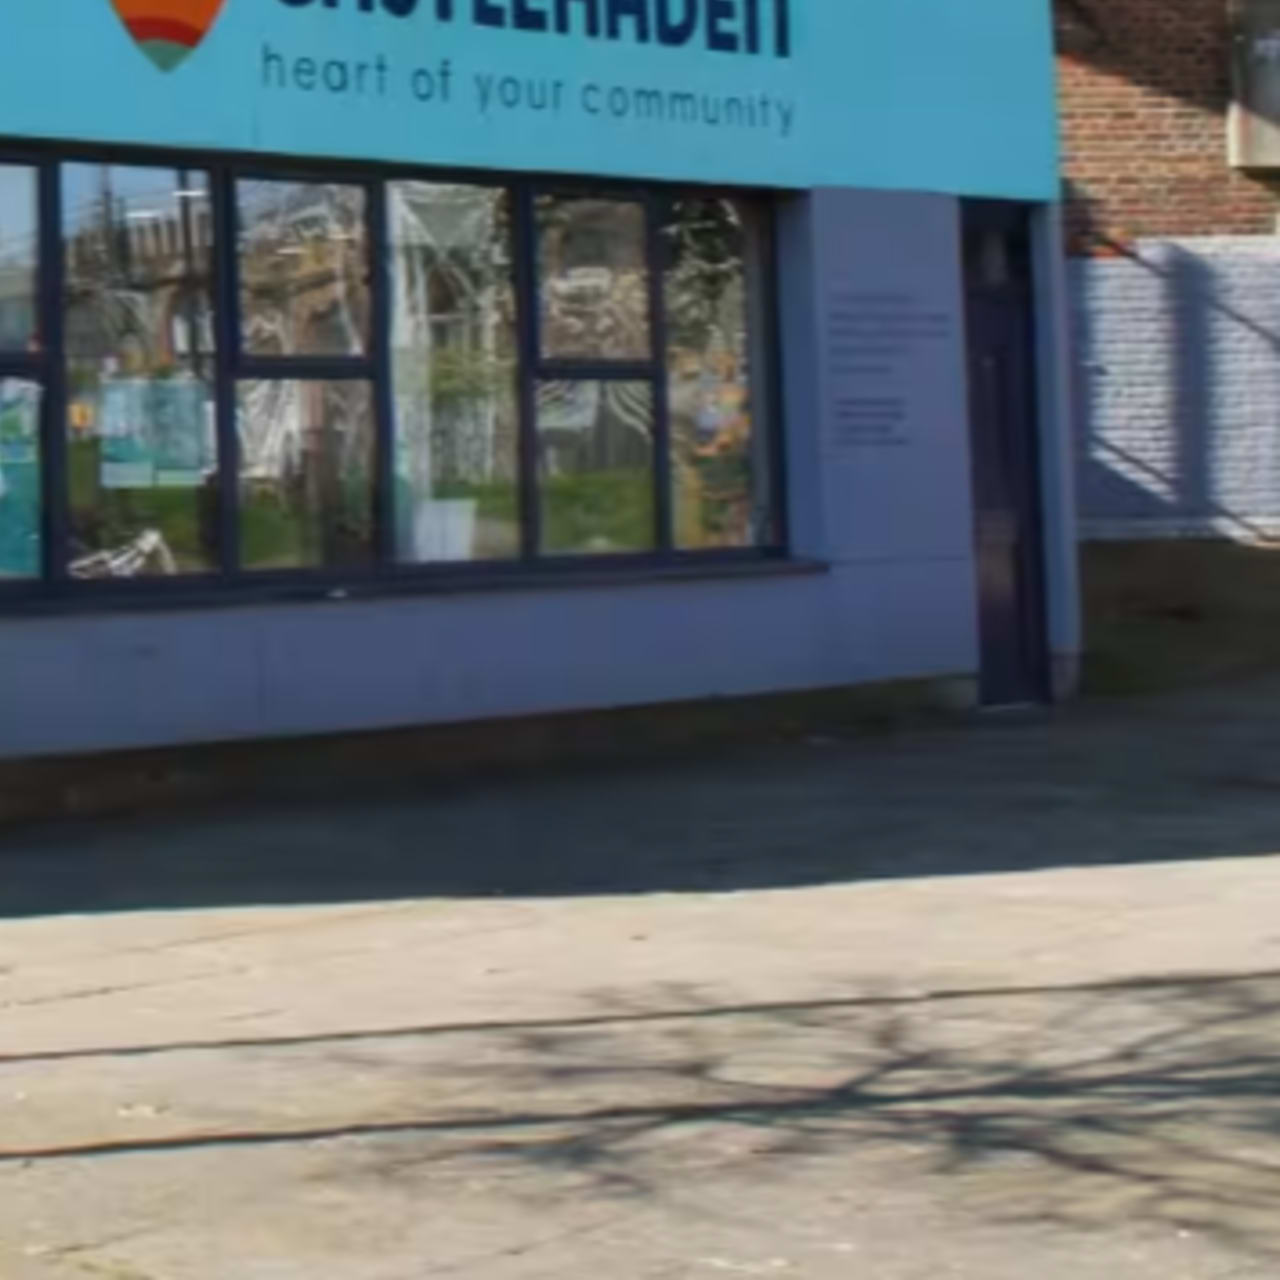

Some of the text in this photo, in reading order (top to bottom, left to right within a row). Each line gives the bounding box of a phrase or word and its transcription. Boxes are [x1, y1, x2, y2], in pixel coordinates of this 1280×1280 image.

[261, 41, 796, 138] heart of your community
